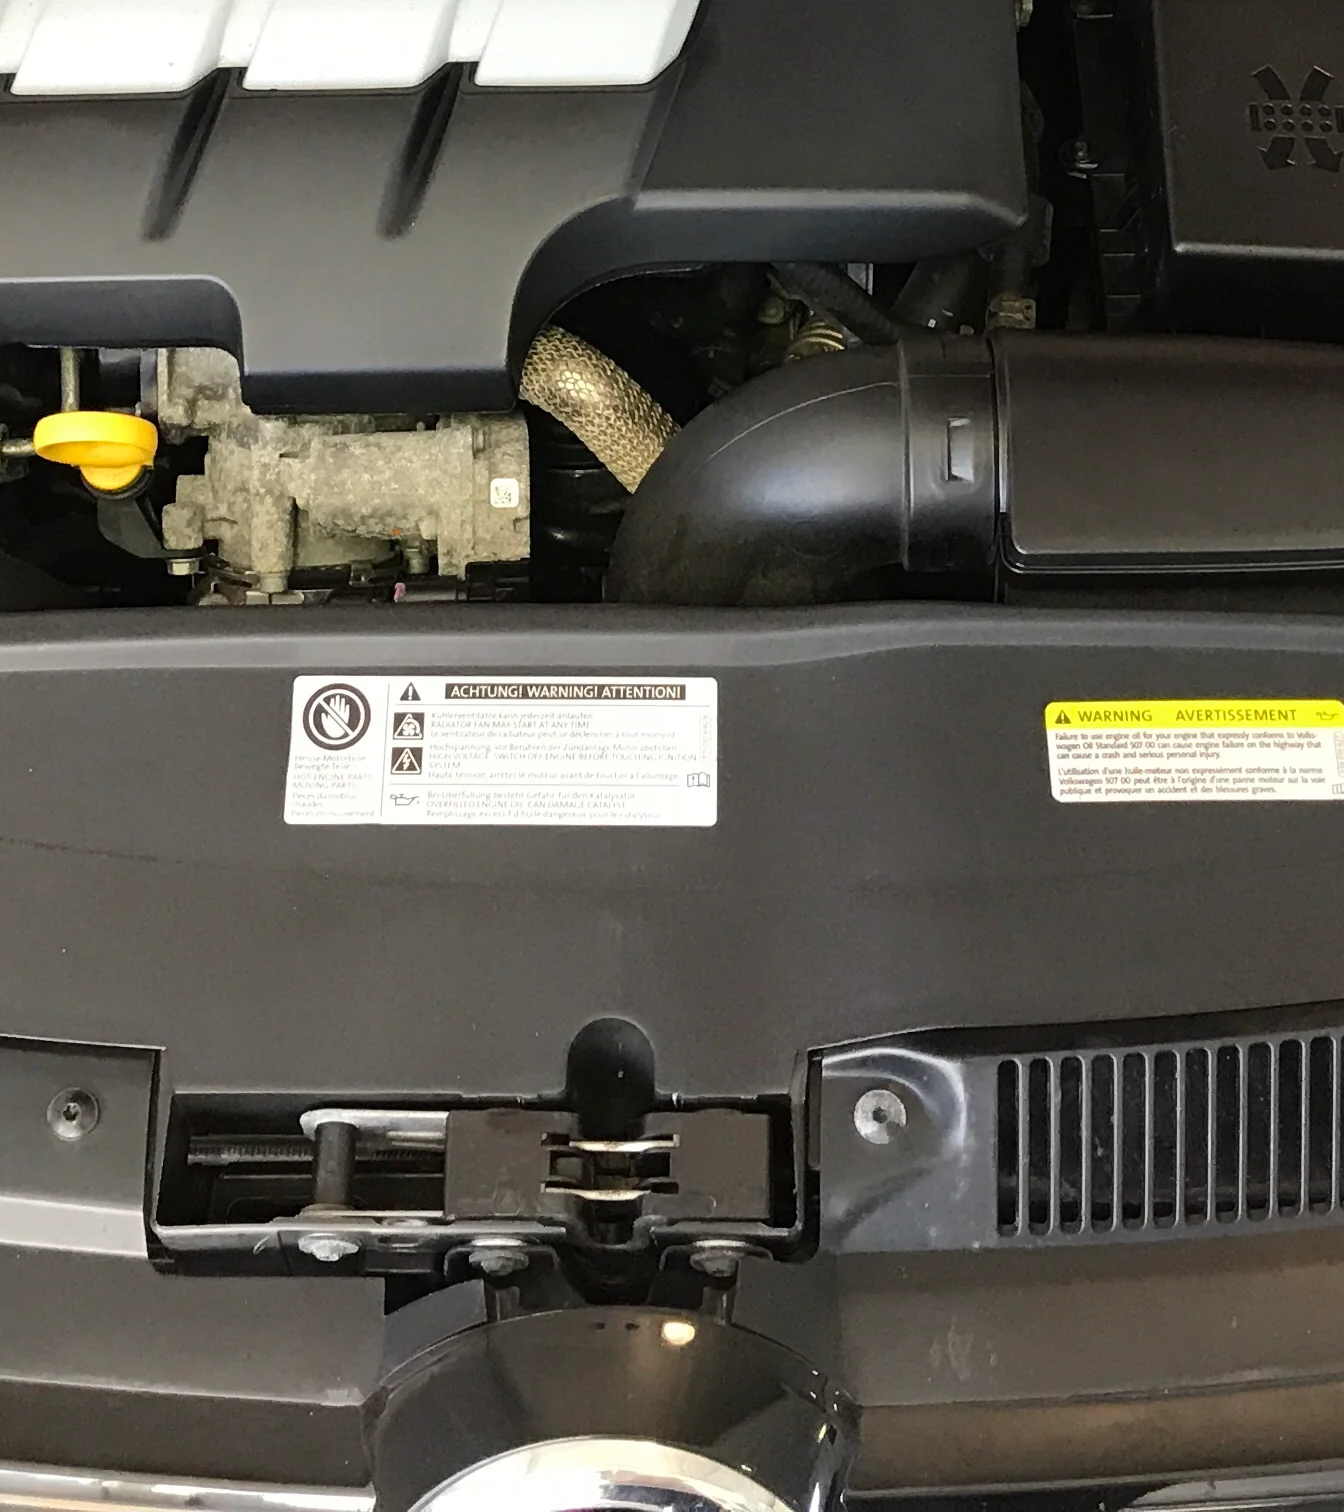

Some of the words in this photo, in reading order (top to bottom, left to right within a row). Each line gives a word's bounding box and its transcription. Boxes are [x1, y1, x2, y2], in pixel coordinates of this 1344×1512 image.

[450, 685, 524, 699] ACHTUNG!
[527, 685, 598, 699] WARNING!
[602, 685, 681, 700] ATTENTION!
[1078, 710, 1153, 722] WARNING
[1176, 710, 1296, 721] AVERTISSEMENT
[1106, 733, 1129, 741] engine
[1174, 732, 1197, 741] engine
